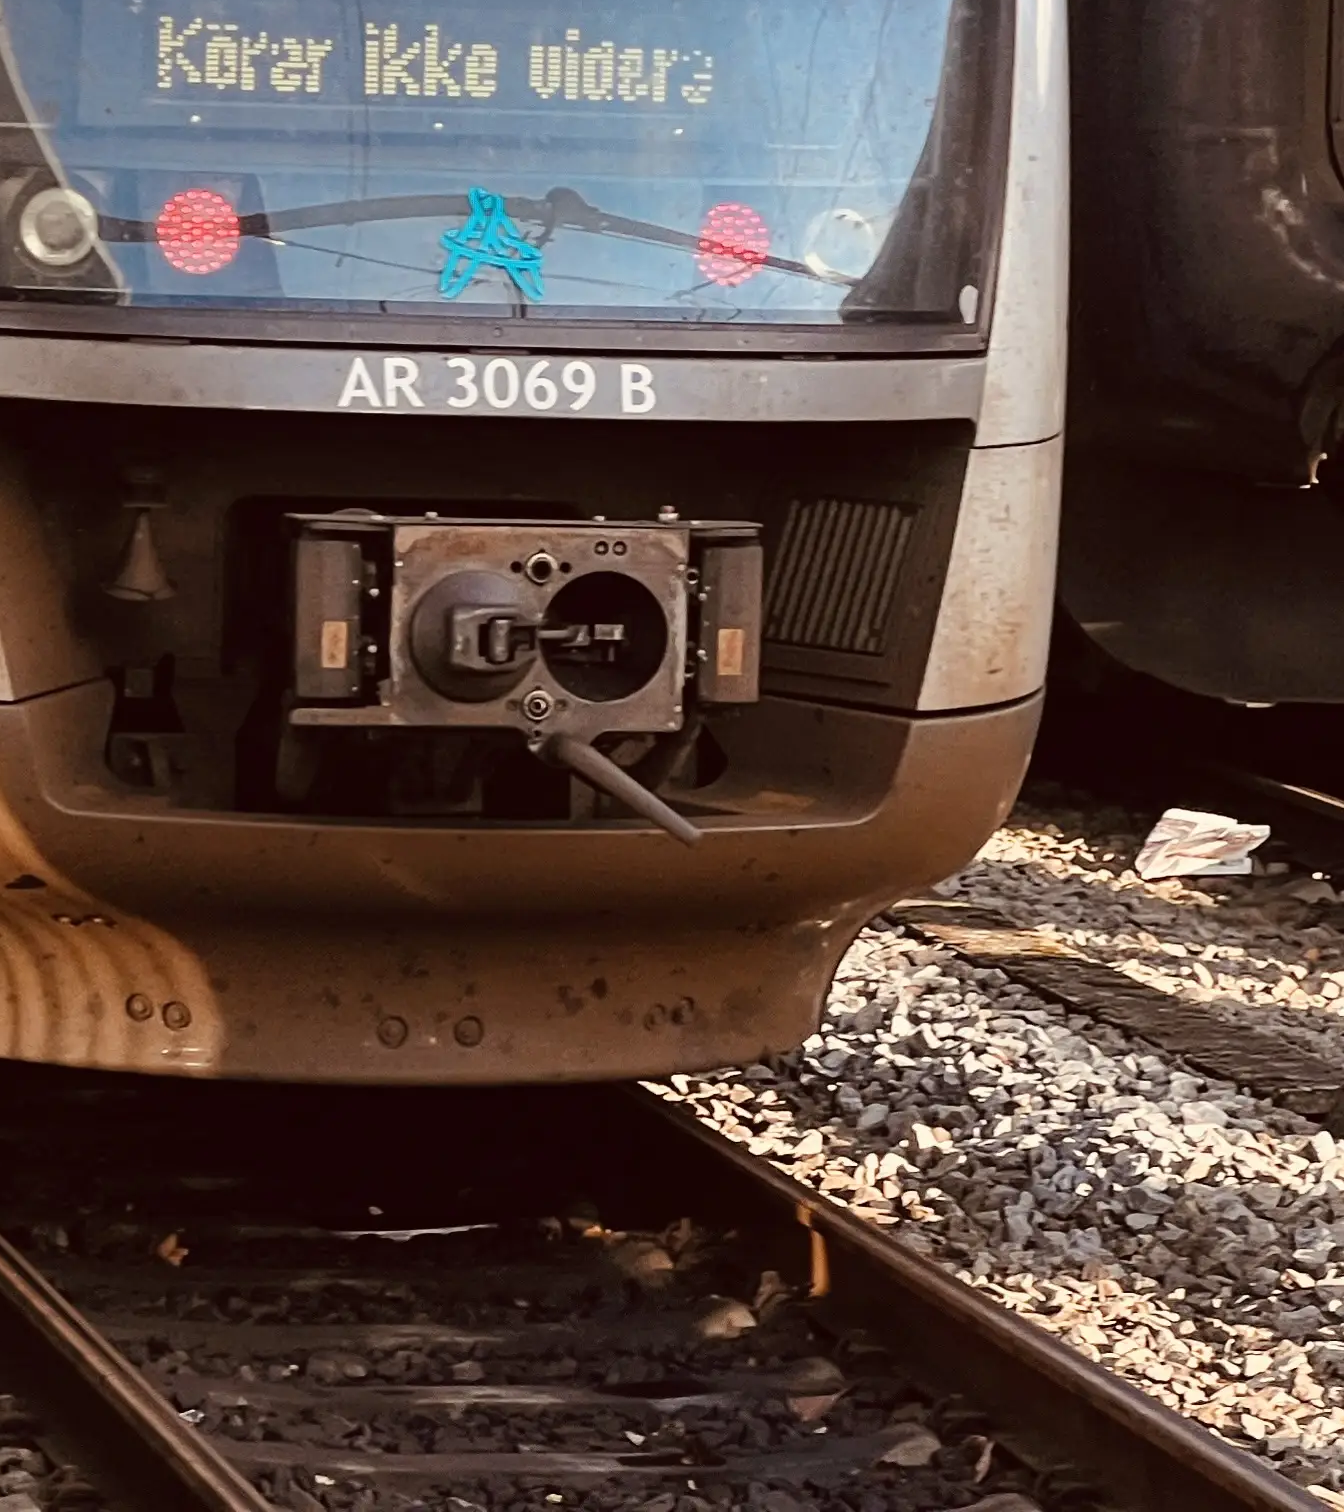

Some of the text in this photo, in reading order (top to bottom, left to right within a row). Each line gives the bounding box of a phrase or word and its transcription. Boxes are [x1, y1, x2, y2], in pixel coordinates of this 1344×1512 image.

[364, 22, 498, 98] ikke
[337, 356, 657, 415] AR 3069 B
